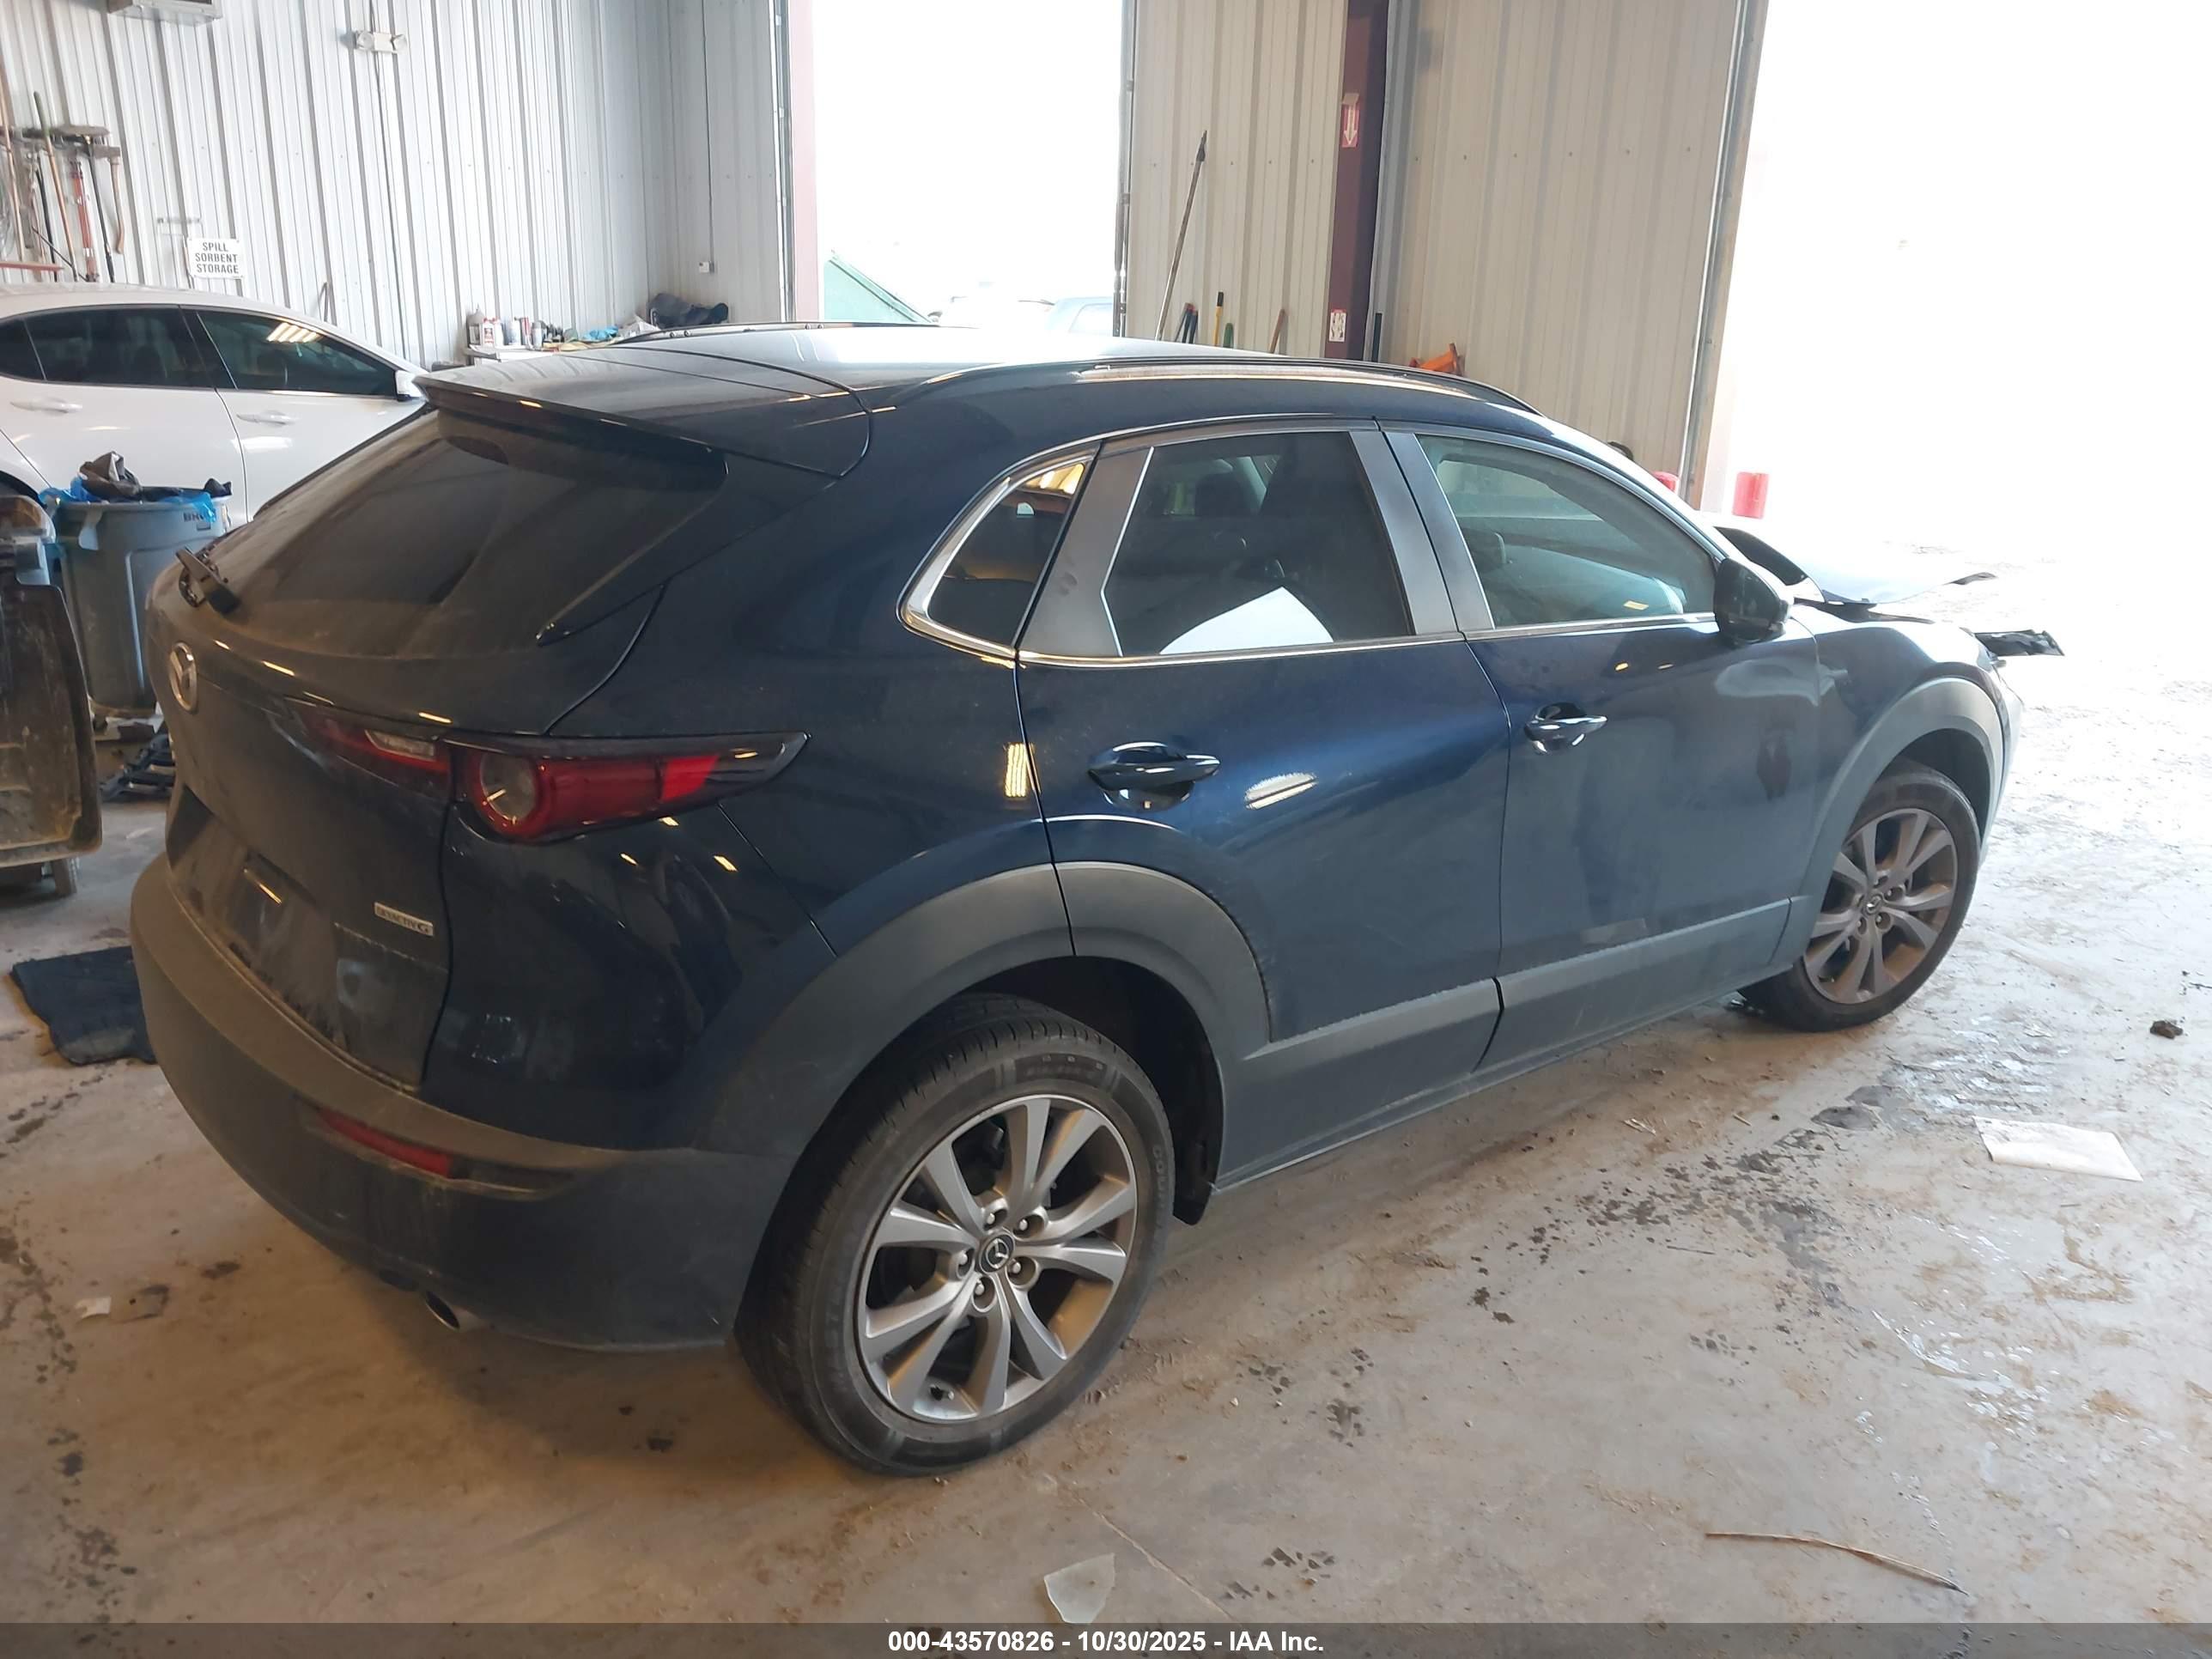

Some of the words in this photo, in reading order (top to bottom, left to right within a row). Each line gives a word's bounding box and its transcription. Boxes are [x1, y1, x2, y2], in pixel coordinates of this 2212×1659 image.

[203, 242, 228, 252] SPILL
[195, 252, 238, 263] SORBENT
[197, 264, 239, 274] STORAGE
